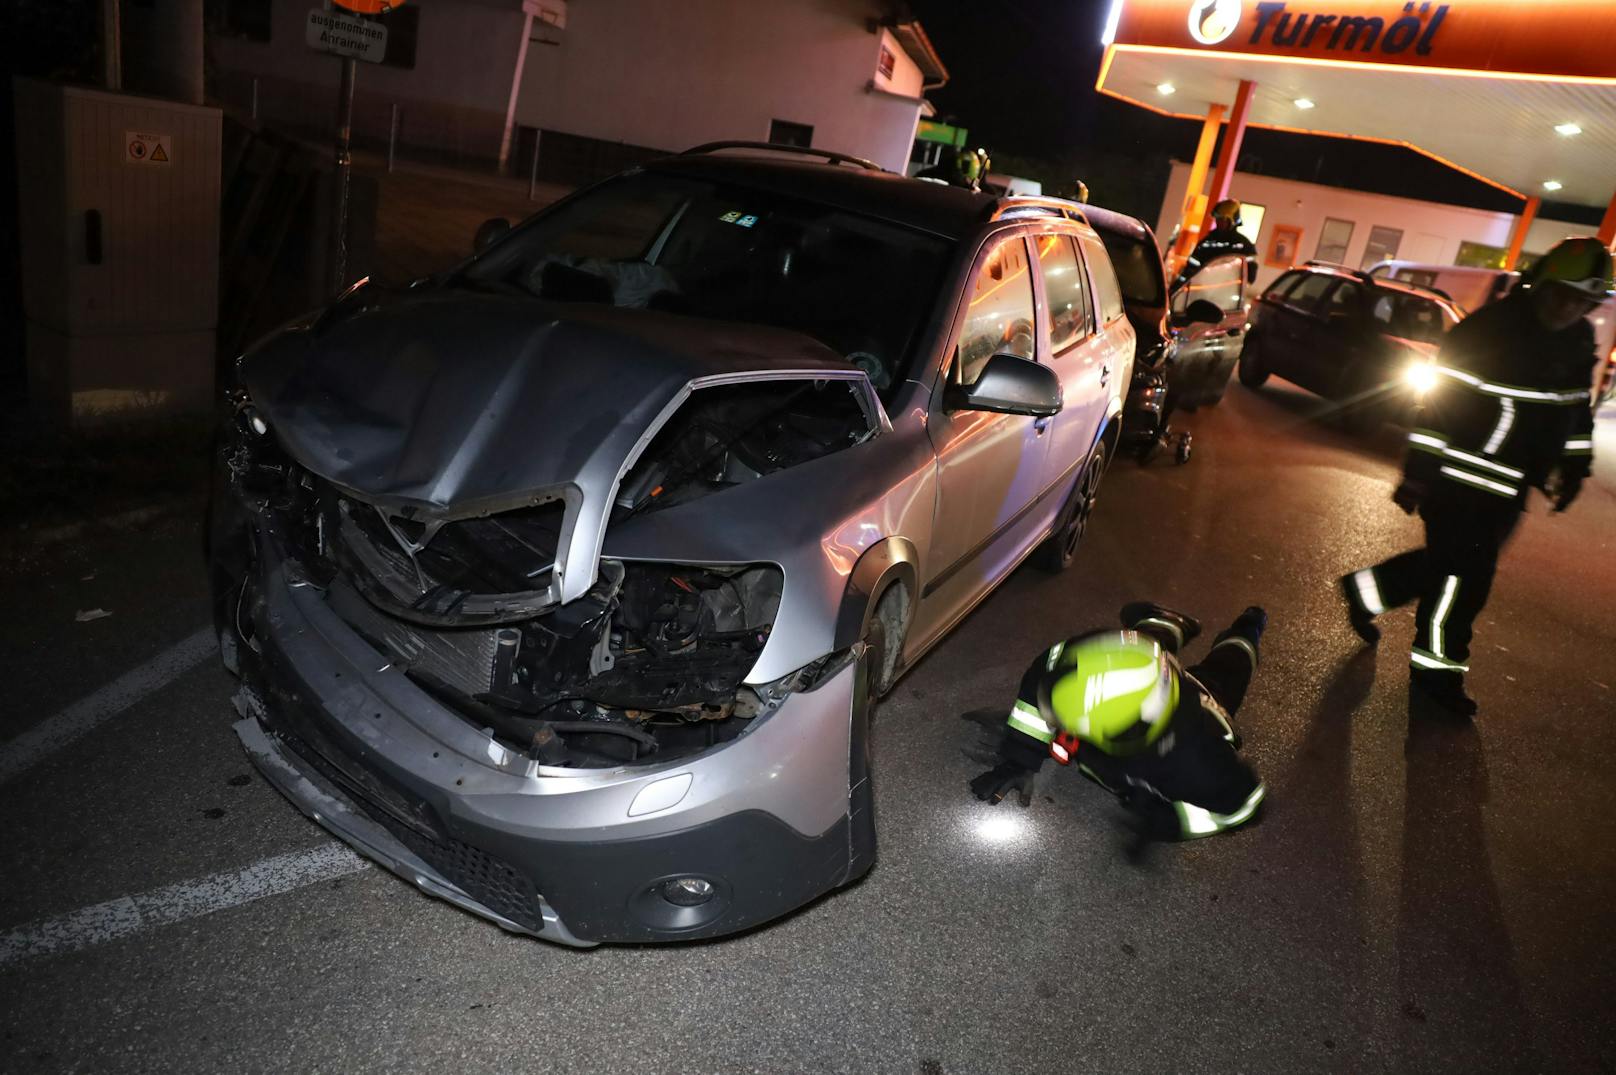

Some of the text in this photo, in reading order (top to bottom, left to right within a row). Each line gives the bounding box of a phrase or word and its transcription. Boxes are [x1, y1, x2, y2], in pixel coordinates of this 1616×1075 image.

[311, 14, 383, 40] ausgenommen
[1248, 2, 1450, 56] Turmöl
[320, 30, 370, 51] Anrainer
